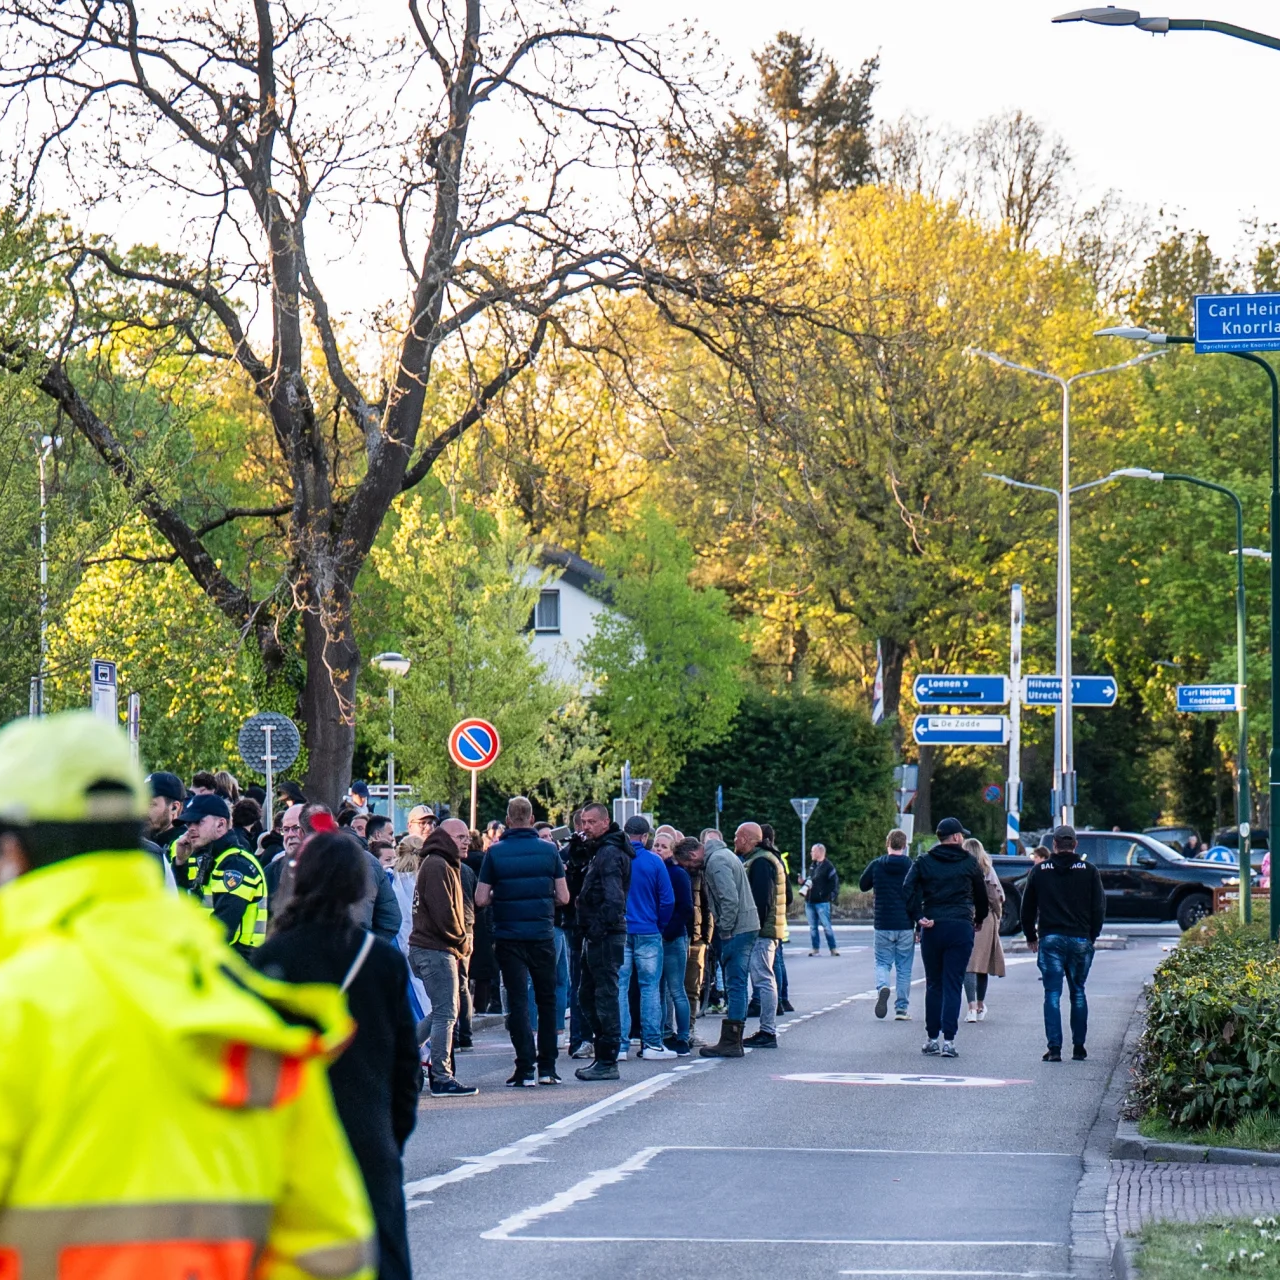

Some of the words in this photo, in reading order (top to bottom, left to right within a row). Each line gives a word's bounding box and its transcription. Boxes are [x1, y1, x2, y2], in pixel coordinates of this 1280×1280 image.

[1208, 303, 1240, 317] Carl
[928, 679, 961, 688] Loenen
[1028, 680, 1074, 689] Hilvers
[1182, 689, 1198, 697] Carl
